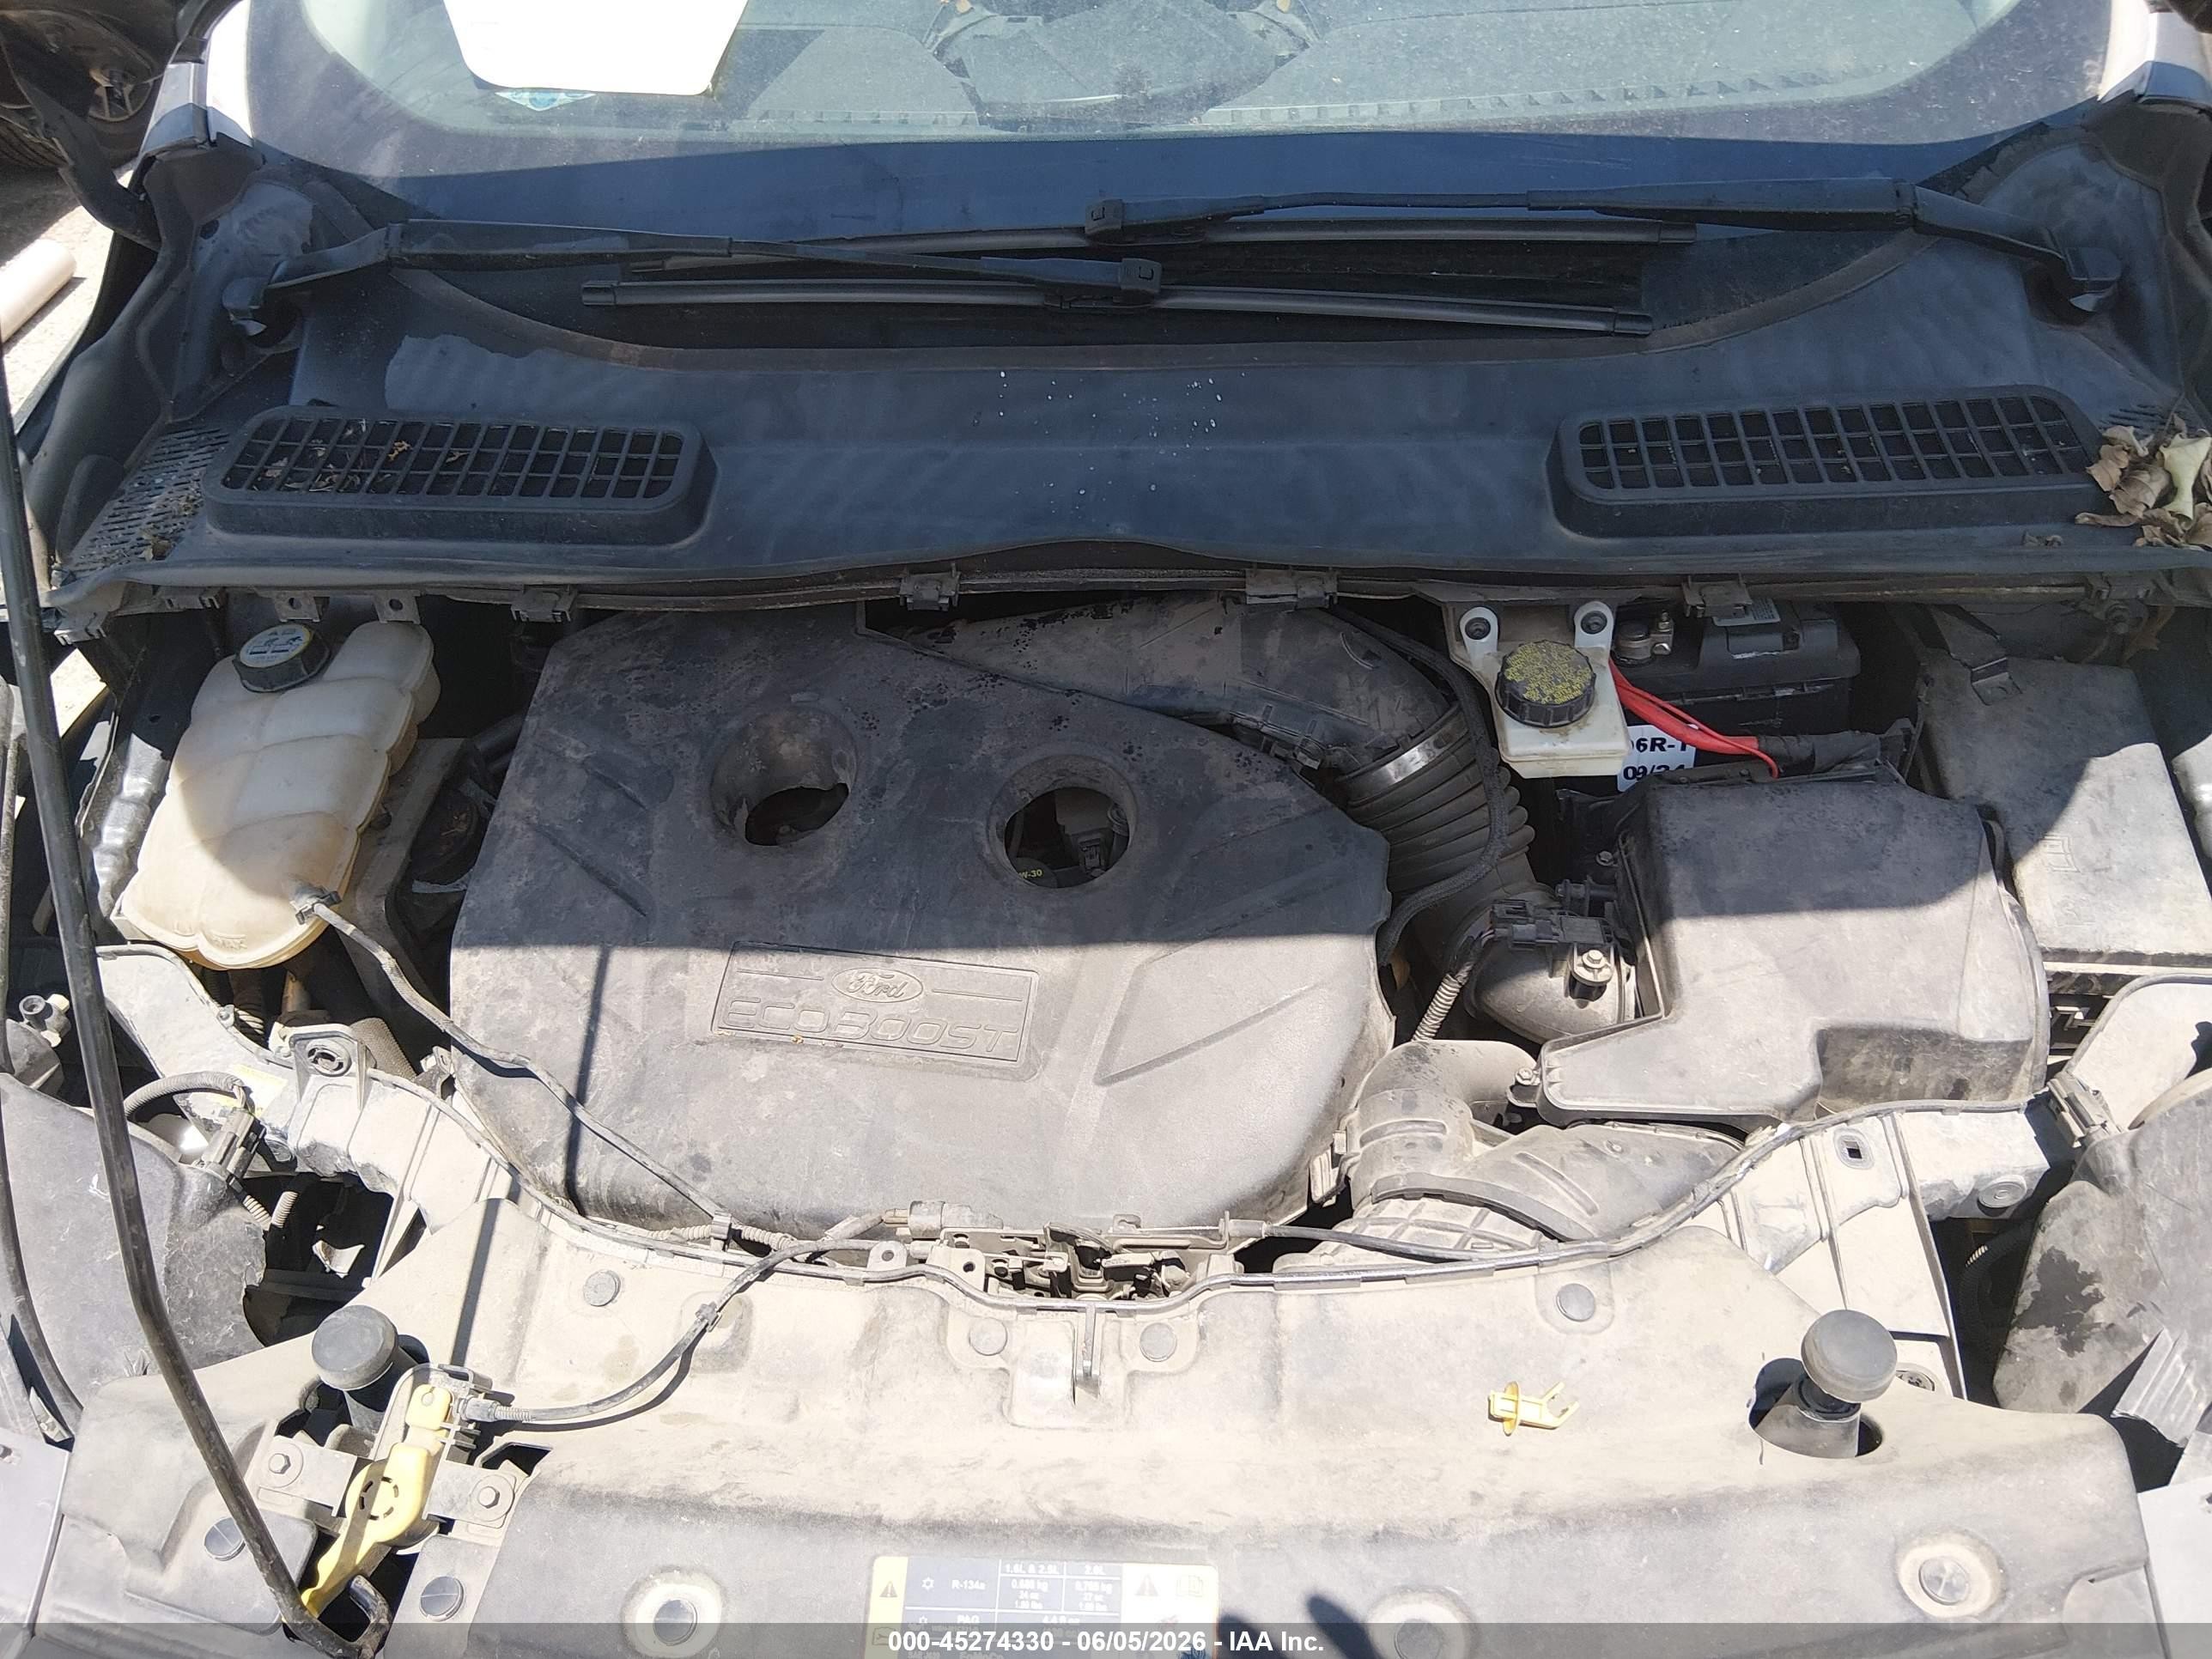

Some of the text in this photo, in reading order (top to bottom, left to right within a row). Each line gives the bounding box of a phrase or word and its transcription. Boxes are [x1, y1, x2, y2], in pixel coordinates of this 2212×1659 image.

[847, 971, 909, 1000] Ford
[720, 996, 1020, 1053] ECOBOOST
[951, 1579, 986, 1590] R-134a
